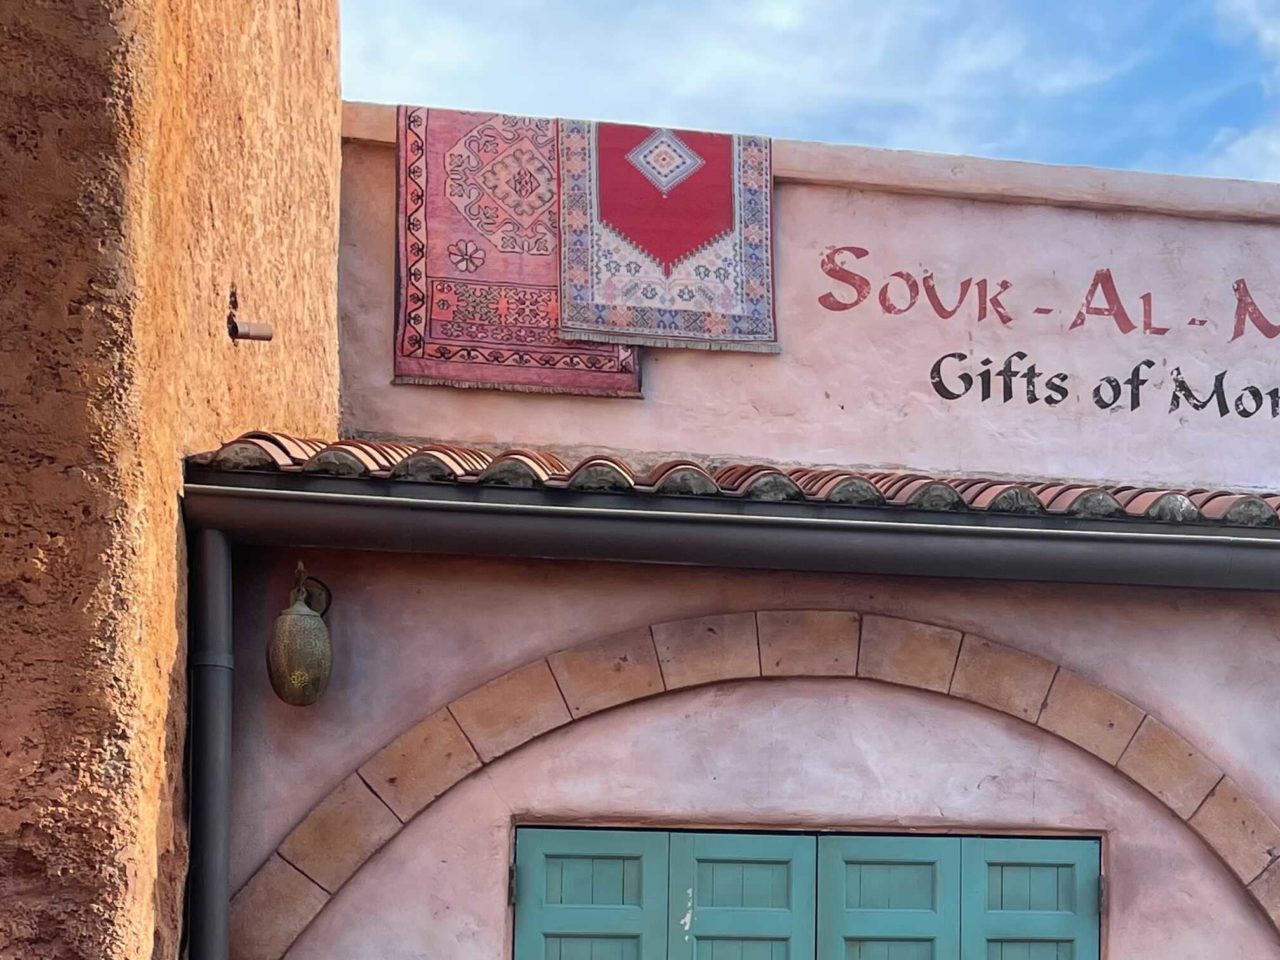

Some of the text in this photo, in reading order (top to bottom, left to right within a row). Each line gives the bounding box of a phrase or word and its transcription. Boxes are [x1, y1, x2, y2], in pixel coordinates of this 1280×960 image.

[1069, 268, 1171, 336] AL
[929, 351, 1070, 405] Gifts
[1092, 358, 1156, 413] of
